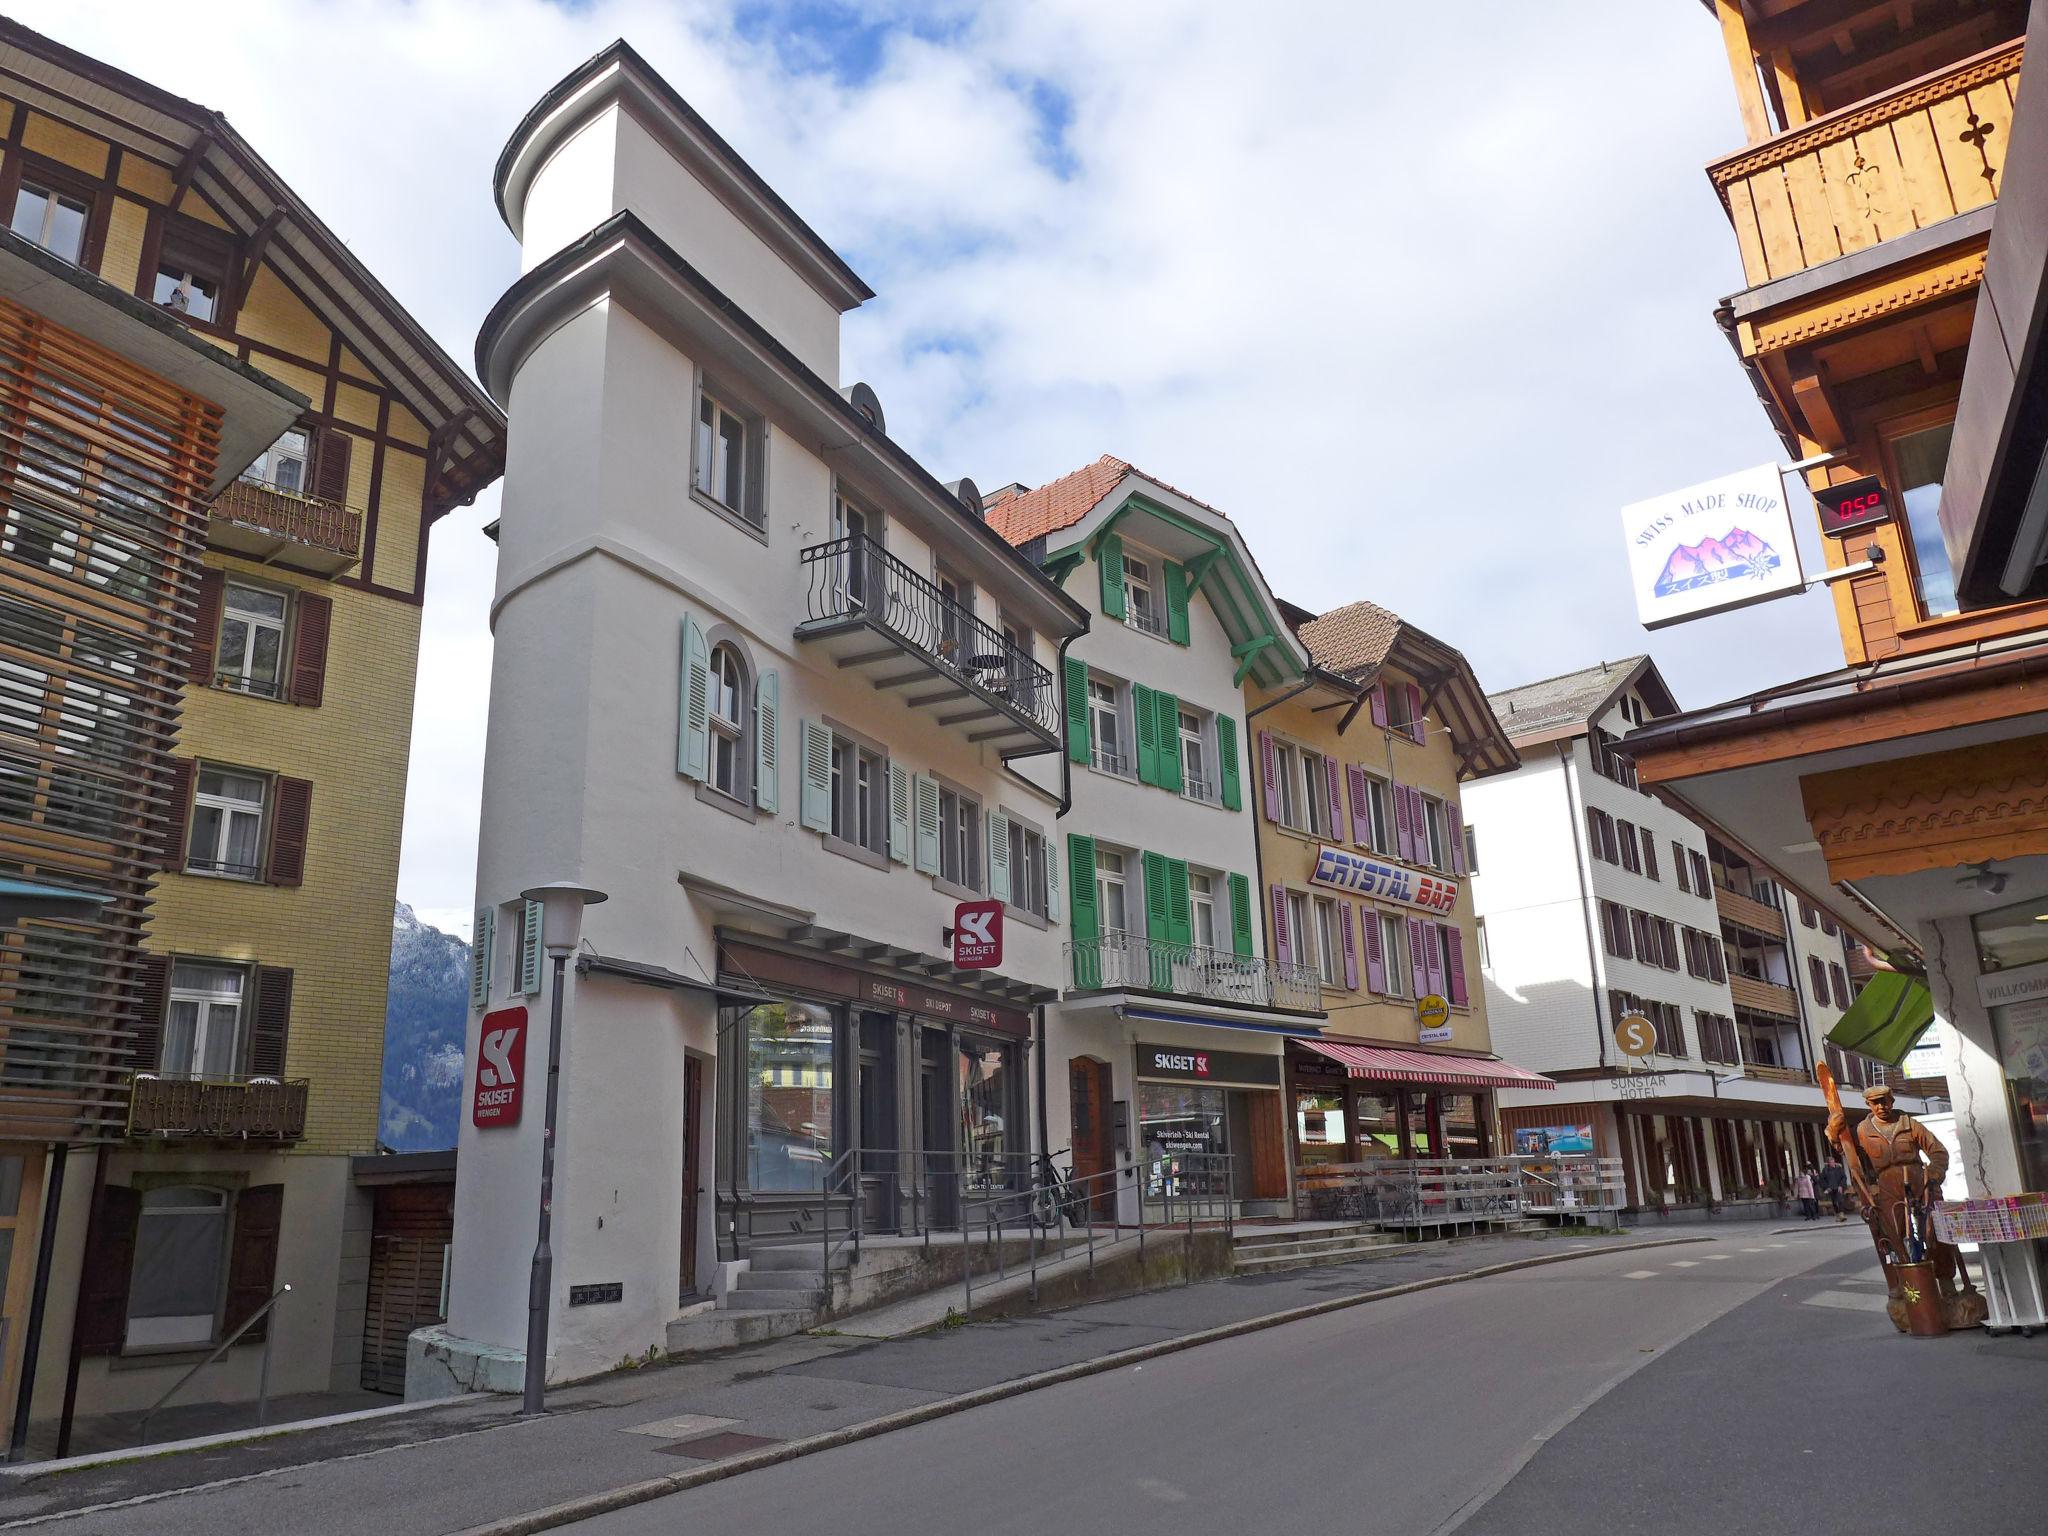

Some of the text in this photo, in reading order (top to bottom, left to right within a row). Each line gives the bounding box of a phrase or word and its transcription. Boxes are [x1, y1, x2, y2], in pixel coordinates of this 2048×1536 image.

[1635, 492, 1778, 549] SWISS MADE SHOP
[1315, 851, 1457, 911] CRYSTAL BAR
[959, 945, 997, 956] SKISET
[872, 983, 897, 999] SKISET
[935, 1000, 952, 1013] DEPOT
[970, 1006, 990, 1020] SKISET
[1627, 1024, 1644, 1050] S
[1155, 1053, 1195, 1071] SKISET
[1610, 1075, 1667, 1090] SUNSTAR
[478, 1088, 515, 1106] SKISET
[1620, 1087, 1657, 1100] HOTEL
[477, 1107, 501, 1118] WENGEN
[1194, 1131, 1210, 1139] Rental
